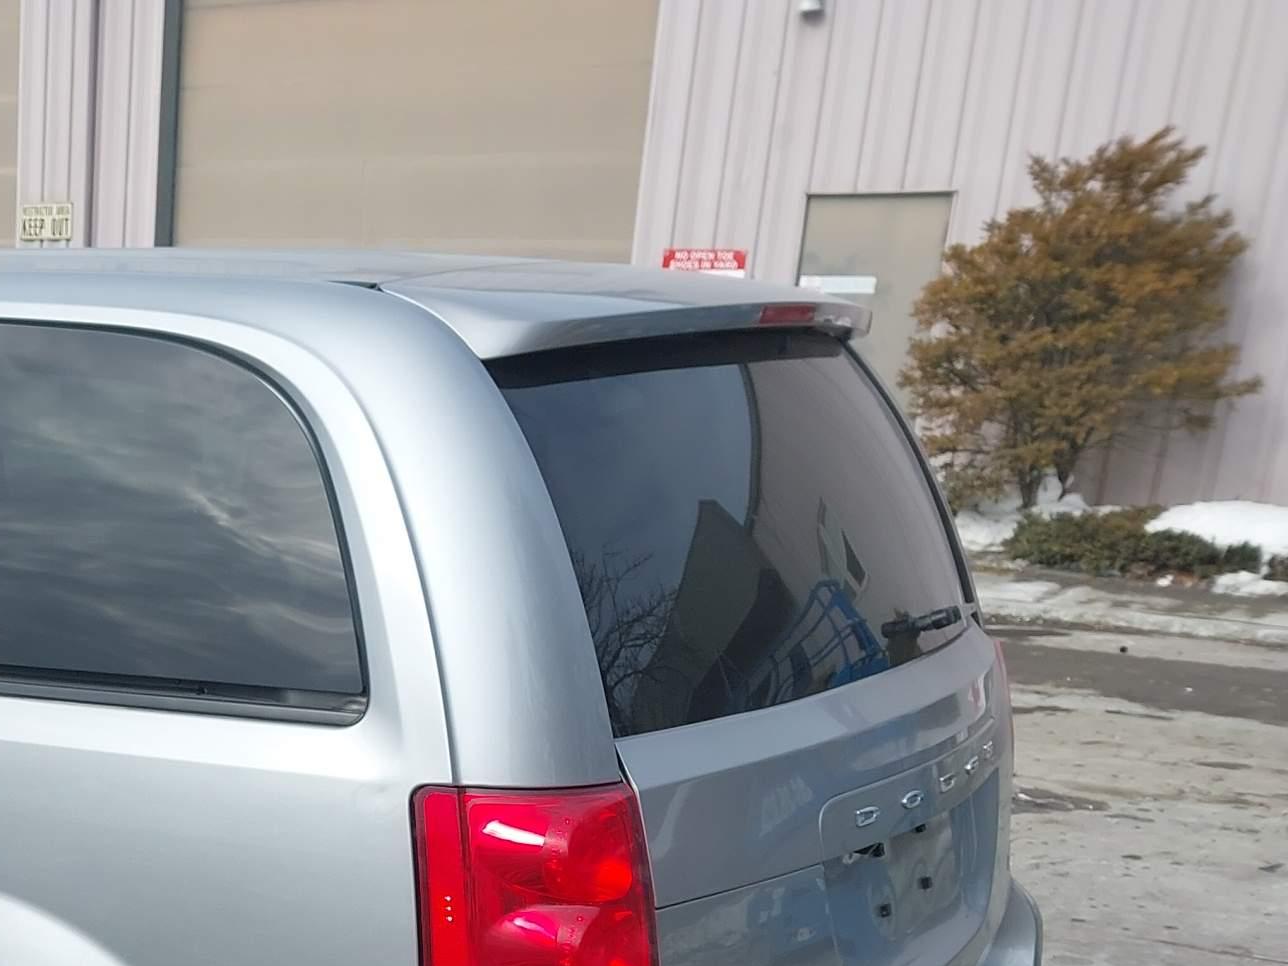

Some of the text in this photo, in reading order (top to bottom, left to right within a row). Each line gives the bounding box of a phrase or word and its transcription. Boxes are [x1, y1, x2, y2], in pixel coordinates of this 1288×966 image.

[22, 218, 69, 237] KEEP OUT
[674, 250, 688, 260] NO
[855, 741, 994, 828] DODGE
